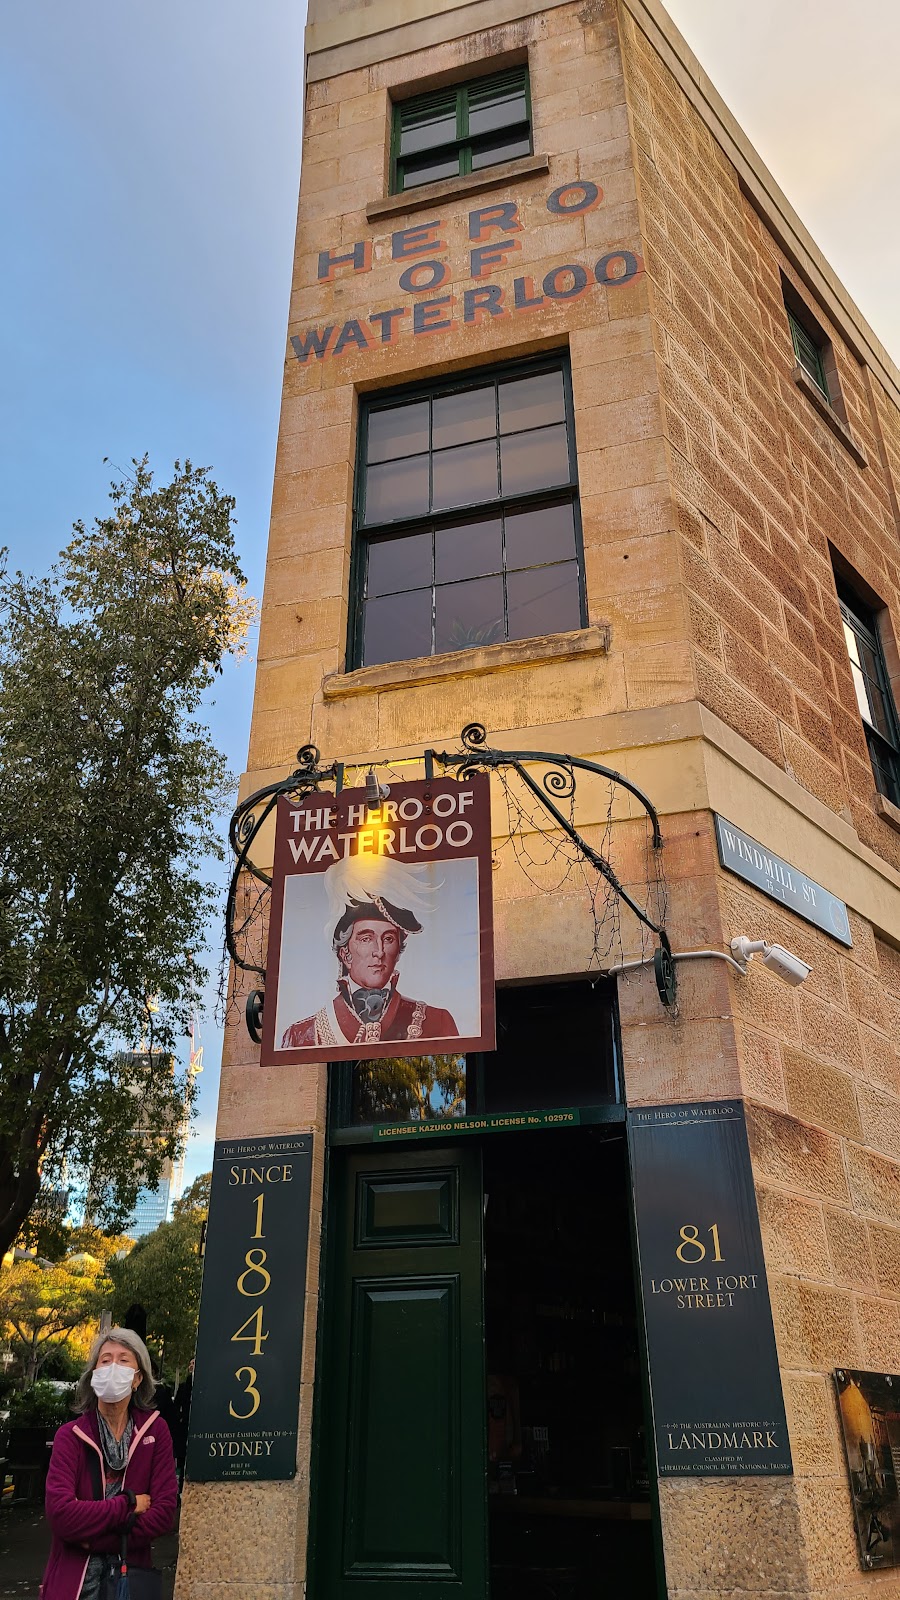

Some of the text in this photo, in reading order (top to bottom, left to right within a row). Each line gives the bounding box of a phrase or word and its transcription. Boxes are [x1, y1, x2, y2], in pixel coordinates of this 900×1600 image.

[316, 181, 604, 284] HERO
[399, 238, 522, 295] OF
[289, 250, 645, 367] WATERLOO
[289, 790, 474, 833] THE HERO OF
[287, 820, 474, 864] WATERLOO
[723, 828, 817, 907] WINDMILL ST
[378, 1113, 574, 1137] LICENSEE KAZUKO NELSON. LICENSE No. 102976
[636, 1107, 734, 1121] THE HERO OF WATERLOO
[222, 1141, 305, 1155] THE HERO OF WATERLOO
[228, 1164, 294, 1186] SINCE
[675, 1223, 726, 1264] 81
[651, 1274, 758, 1294] LOWER FORT
[676, 1292, 735, 1309] STREET
[208, 1440, 275, 1457] SYDNEY
[667, 1431, 780, 1450] LANDMARK
